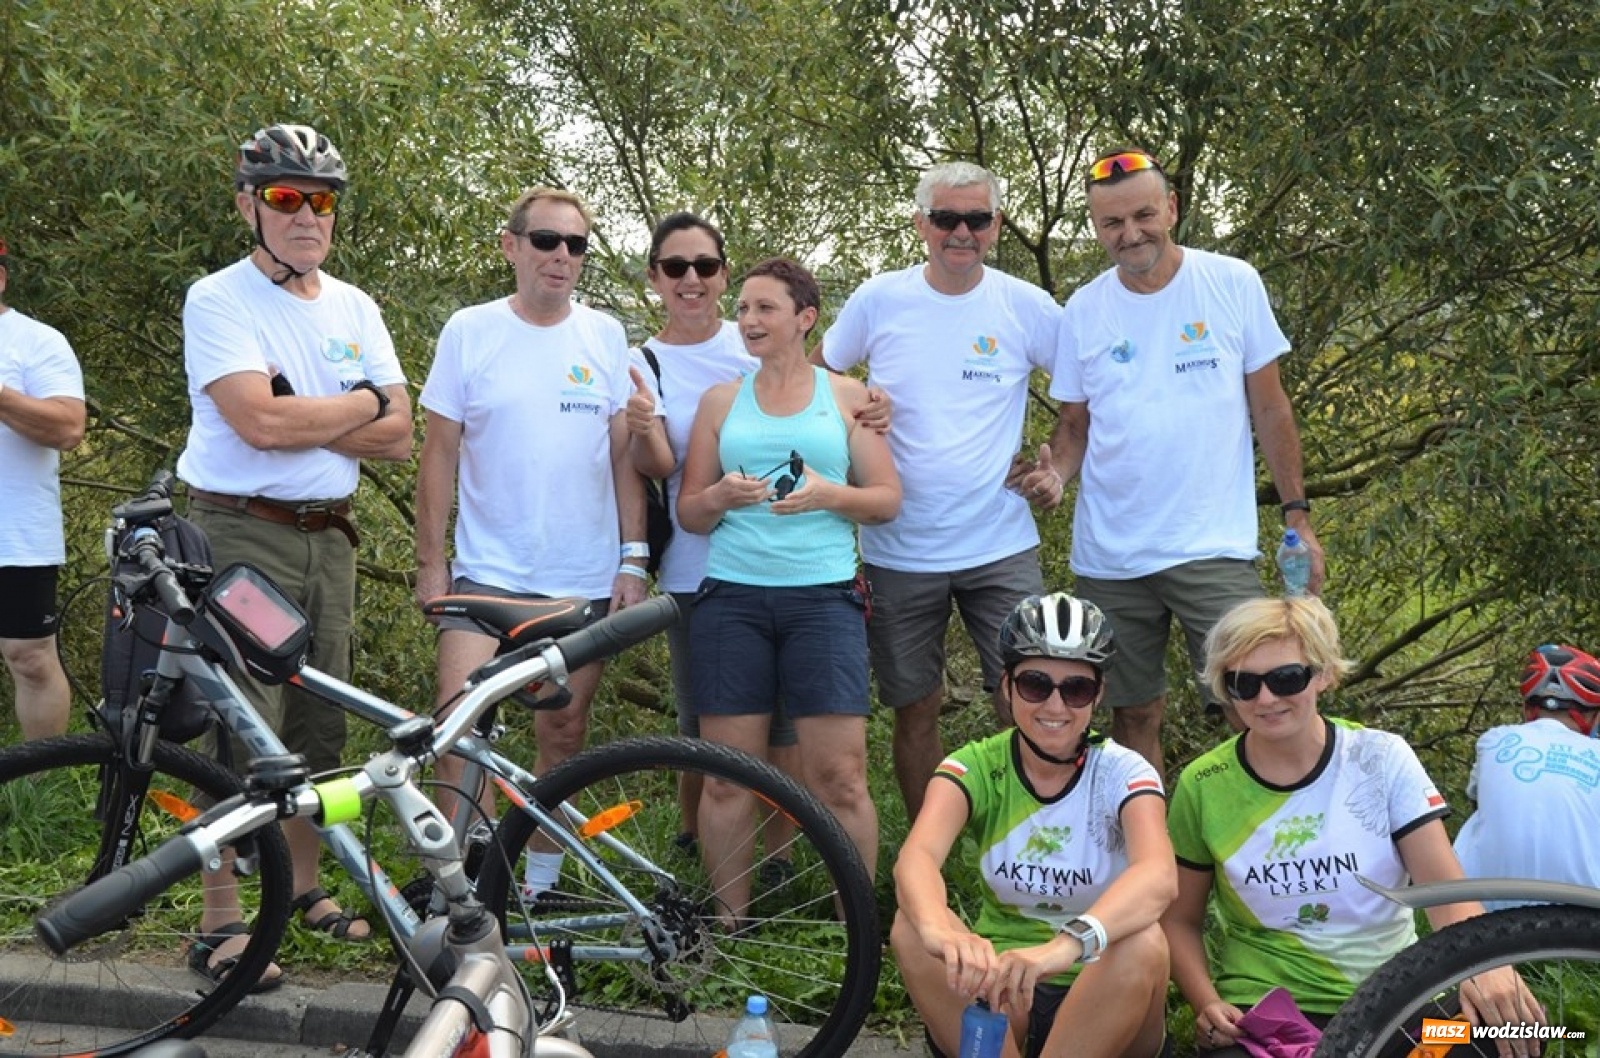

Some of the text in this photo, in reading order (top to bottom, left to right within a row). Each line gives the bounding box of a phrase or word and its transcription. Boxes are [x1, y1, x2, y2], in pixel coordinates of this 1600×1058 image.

[1194, 762, 1229, 781] deep
[994, 860, 1093, 886] AKTYWNI
[1244, 852, 1358, 885] AKTYWNI
[1014, 881, 1074, 897] LYSKI
[1269, 876, 1339, 896] LYSKI
